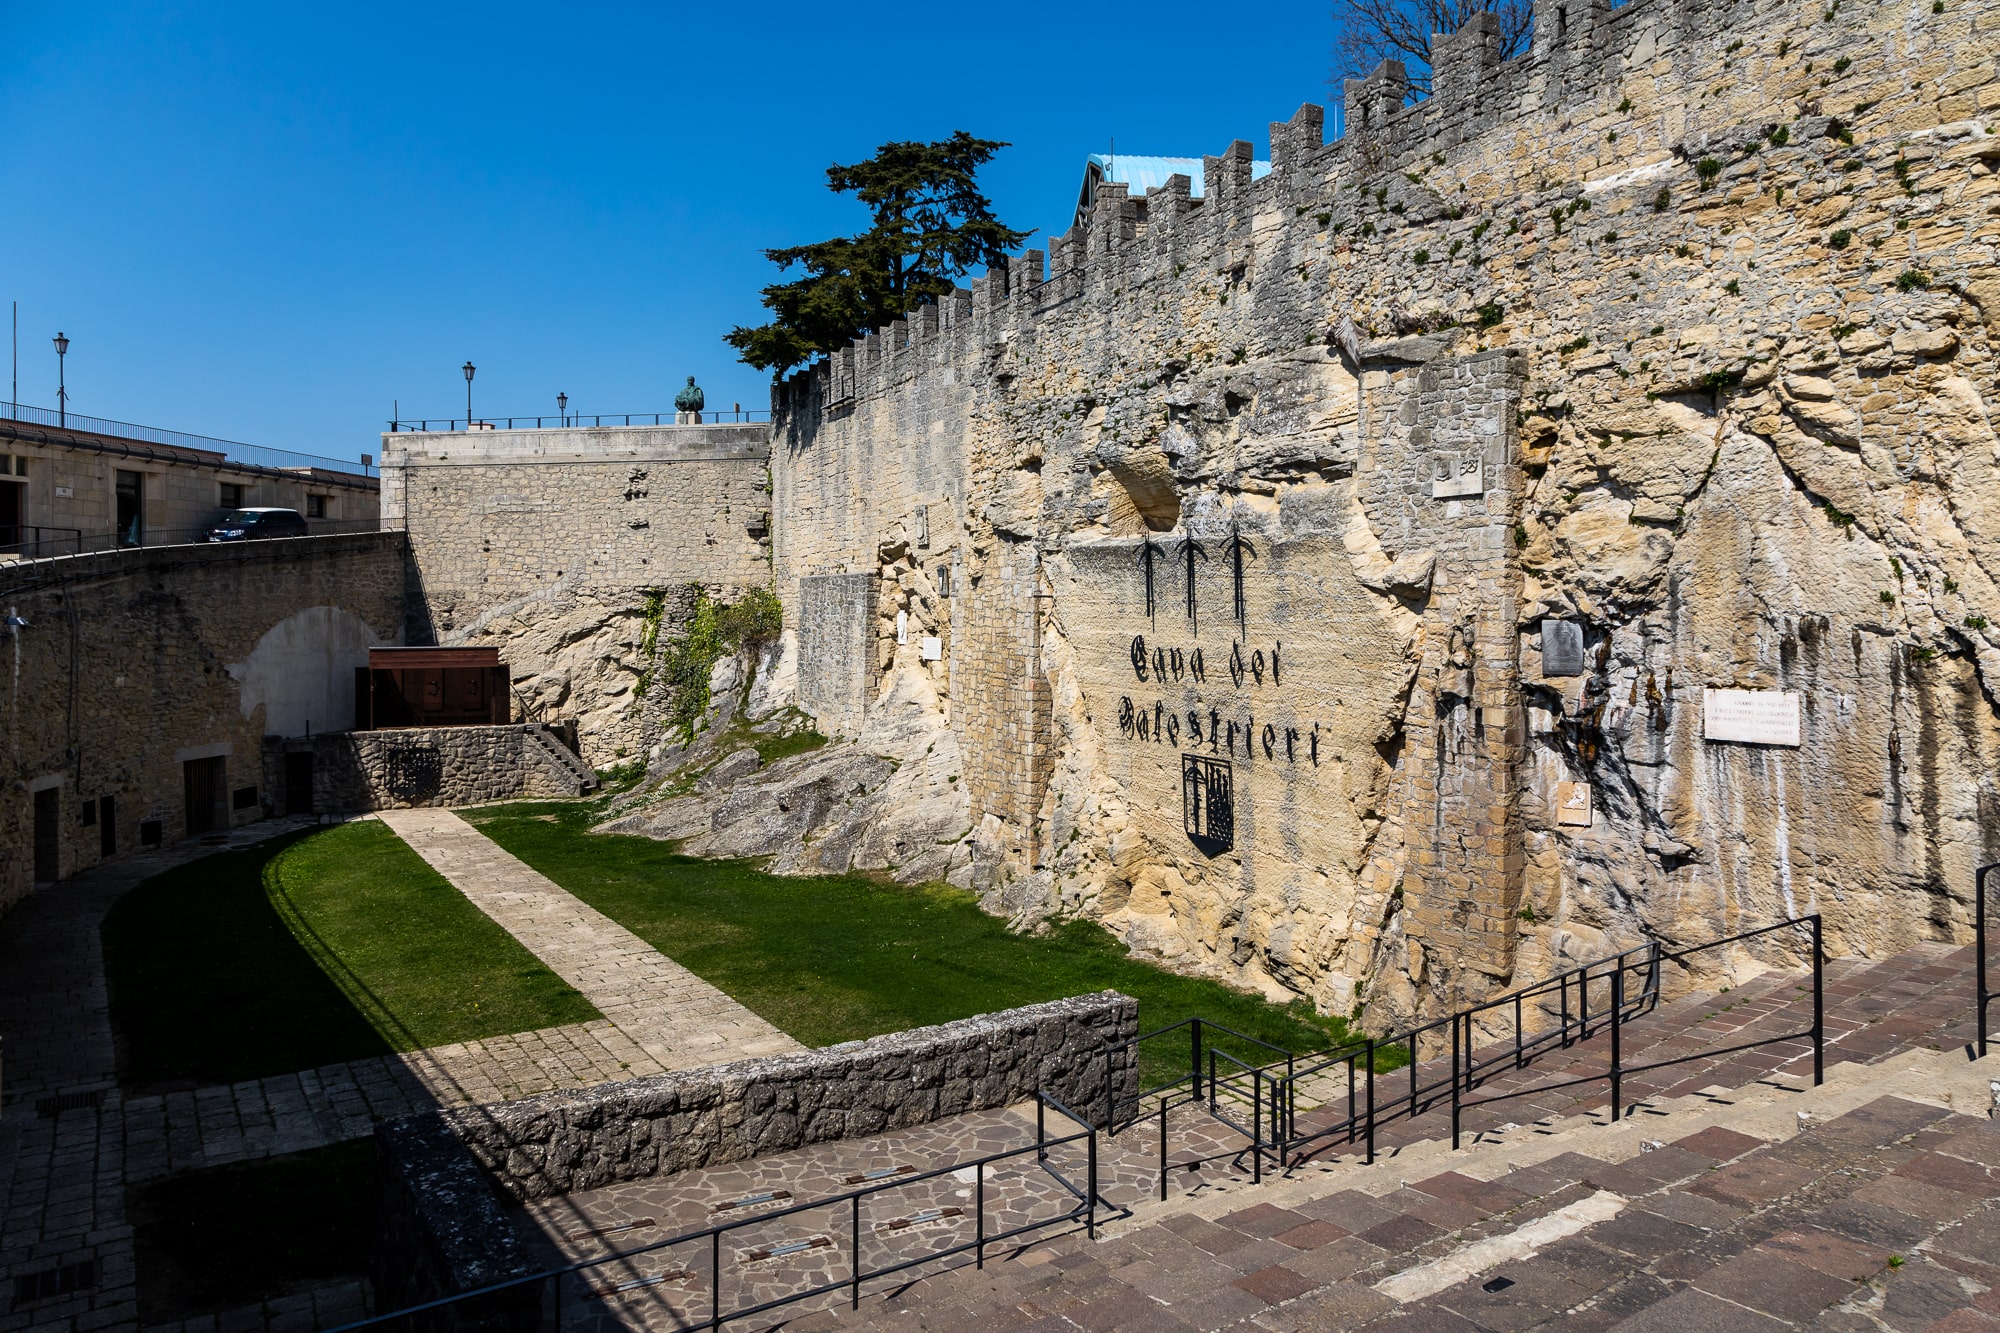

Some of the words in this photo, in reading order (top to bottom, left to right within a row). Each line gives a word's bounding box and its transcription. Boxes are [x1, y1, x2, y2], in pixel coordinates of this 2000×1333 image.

[1131, 635, 1206, 684] Cava
[1229, 639, 1282, 689] dei
[1118, 696, 1320, 768] Balestrieri
